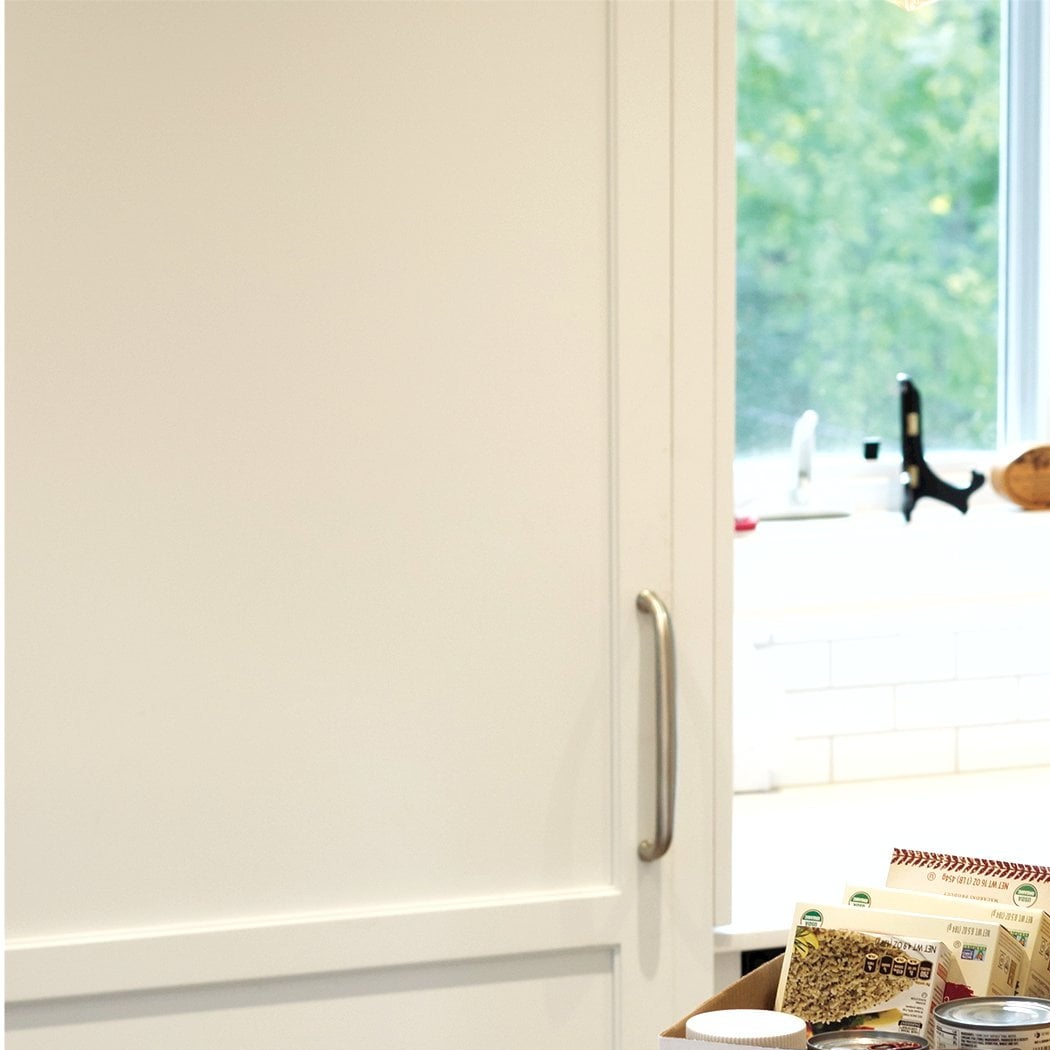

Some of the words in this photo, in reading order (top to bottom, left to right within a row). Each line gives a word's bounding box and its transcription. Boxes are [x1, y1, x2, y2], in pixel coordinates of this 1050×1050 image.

[973, 879, 981, 887] OZ
[988, 880, 998, 889] WT
[998, 882, 1009, 890] NET
[911, 943, 923, 952] WT
[923, 944, 937, 954] NET
